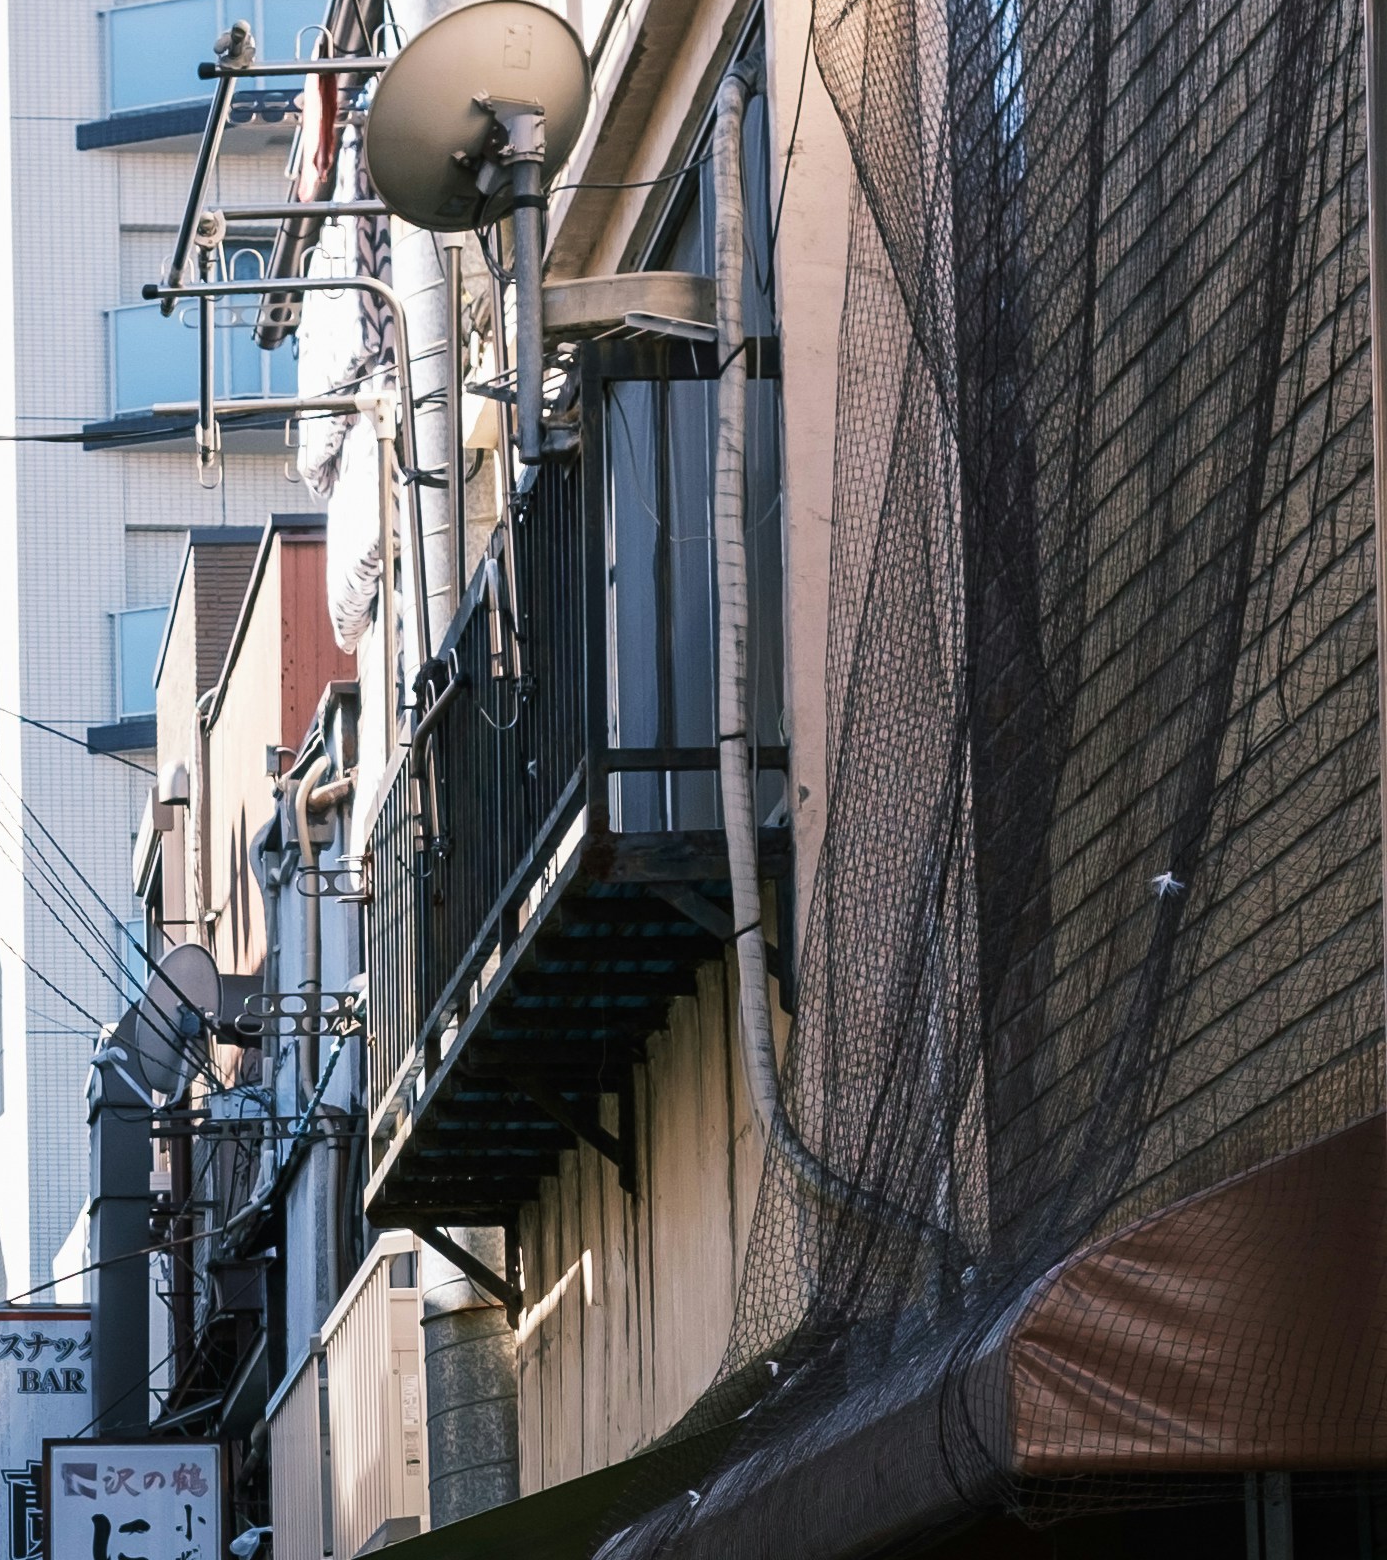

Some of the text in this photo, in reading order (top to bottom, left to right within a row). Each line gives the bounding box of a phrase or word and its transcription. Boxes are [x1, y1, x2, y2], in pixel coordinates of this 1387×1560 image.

[18, 1368, 87, 1394] BAR
[103, 1462, 210, 1498] 沢の鶴
